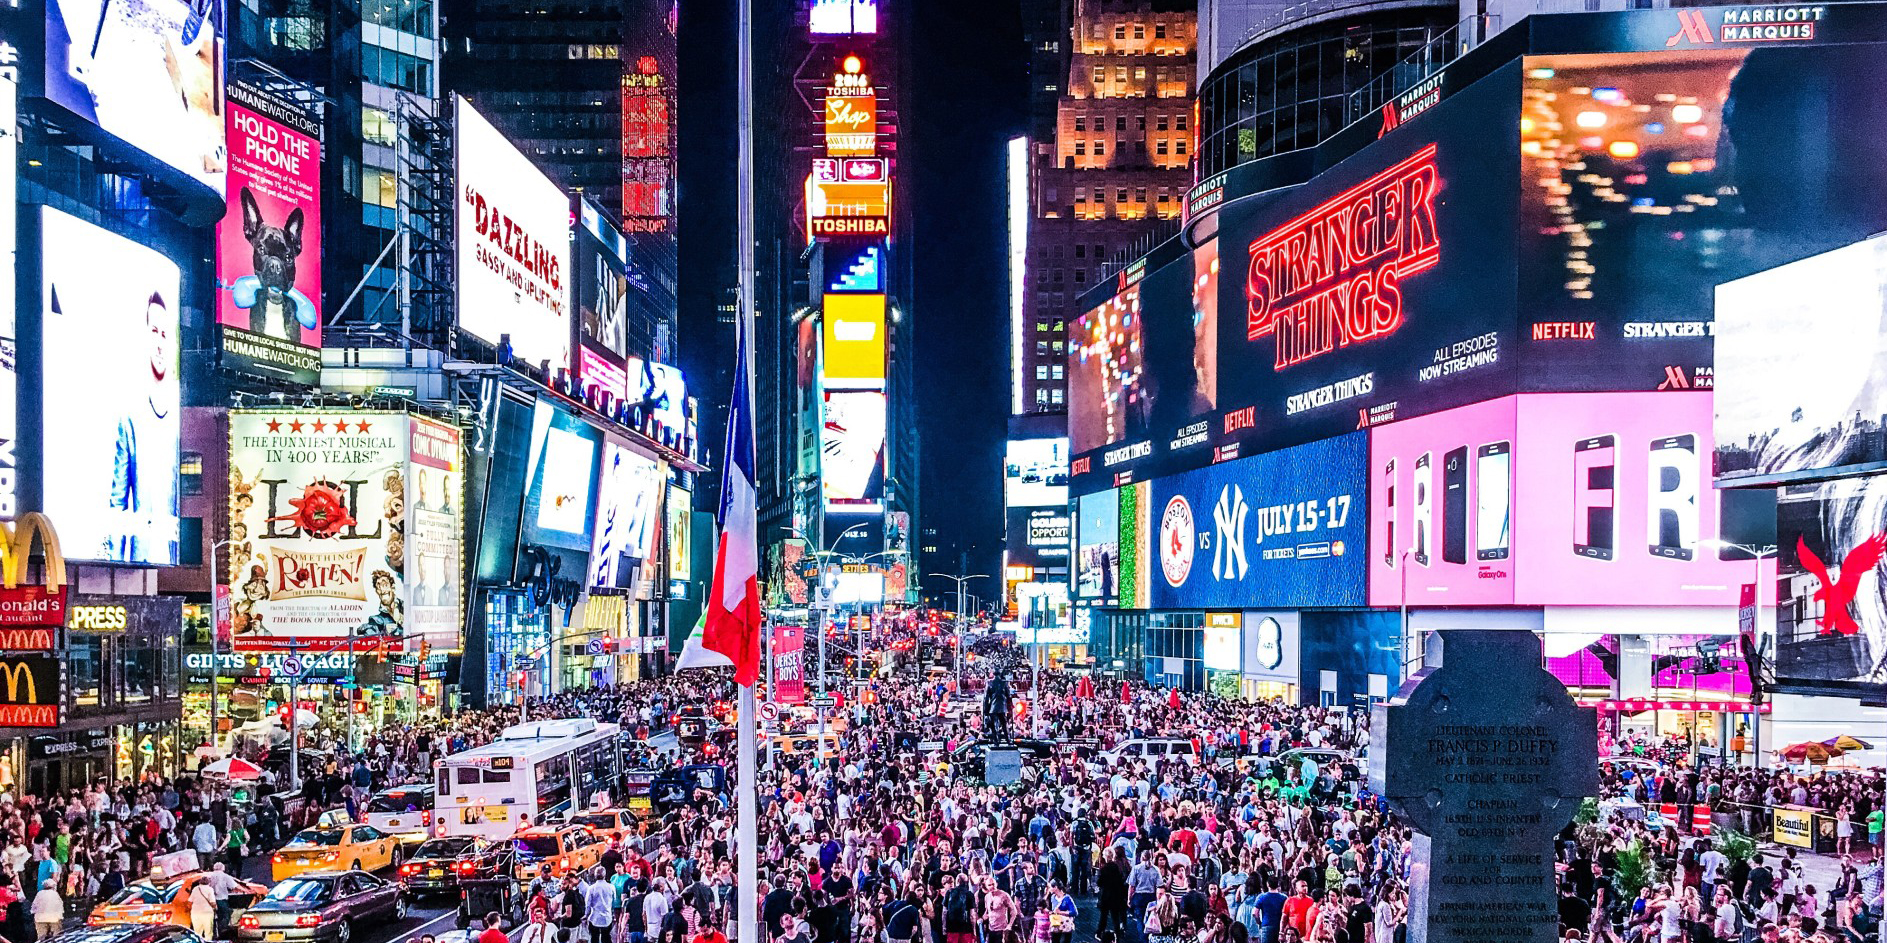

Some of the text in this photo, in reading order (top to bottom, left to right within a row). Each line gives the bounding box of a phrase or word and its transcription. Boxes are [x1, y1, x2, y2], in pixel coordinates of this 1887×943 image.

[1724, 7, 1824, 23] MARRIOTT
[1724, 25, 1811, 39] MARQUIS
[827, 87, 875, 96] TOSHIBA
[1401, 71, 1446, 107] MARRIOTT
[1401, 91, 1439, 121] MARQUIS
[234, 110, 310, 160] HOLD THE
[232, 153, 242, 163] The
[246, 136, 300, 175] PHONE
[1191, 174, 1228, 201] MARRIOTT
[1191, 190, 1221, 214] MARQUIS
[813, 219, 887, 232] TOSHIBA
[1248, 160, 1440, 326] STRANGER
[476, 243, 523, 290] SASSY AND
[1270, 260, 1403, 370] THINGS
[1532, 322, 1705, 341] NETFLIX STRANGER
[1433, 332, 1497, 362] ALL EPISODES
[223, 338, 320, 372] HUMANEWATCH.ORG
[1419, 348, 1497, 381] NOW STREAMING
[1286, 371, 1374, 416] STRANGER THINGS
[1370, 402, 1398, 415] MARRIOTT
[1224, 406, 1255, 435] NETFLIX
[1370, 411, 1394, 424] MARQUIS
[1177, 420, 1207, 438] ALL EPISODES
[243, 436, 396, 449] THE FUNNIEST MUSICAL
[1170, 431, 1208, 450] NOW STREAMING
[267, 450, 282, 463] IN
[288, 450, 316, 463] 400
[1071, 456, 1091, 477] NETFLIX
[259, 478, 382, 540] LOL
[1165, 503, 1190, 531] BOSTON
[1256, 503, 1294, 544] JULY
[426, 530, 444, 541] FULLY
[1198, 531, 1210, 549] VS
[417, 541, 453, 555] COMMITTED
[284, 552, 353, 562] SOMETHING
[1478, 571, 1496, 580] Galaxy
[583, 595, 621, 629] FOREVER
[774, 651, 803, 668] JERSEY
[241, 676, 268, 684] Canon
[779, 666, 799, 681] BOYS
[1436, 726, 1549, 736] LIEUTENANT COLONEL
[45, 741, 77, 754] EXPRESS
[92, 736, 119, 748] EXPRESS
[1428, 739, 1558, 752] FRANCIS DUFFY
[1436, 757, 1455, 766] MAY
[1529, 757, 1550, 766] 1932
[1445, 774, 1541, 784] CATHOLIC PRIEST
[1467, 800, 1517, 810] CHAPLAIN
[1496, 814, 1542, 823] INFANTRY
[1776, 815, 1809, 831] Beautiful
[1458, 827, 1479, 837] OLD
[1446, 854, 1542, 864] A LIFE OF SERVICE
[1442, 875, 1545, 885] GOD AND COUNTRY
[1439, 902, 1548, 911] SPANISH AMERICAN WAR
[1428, 915, 1558, 924] NEW YORK NATIONAL GUARD
[1452, 927, 1534, 937] MEXICAN BORDER
